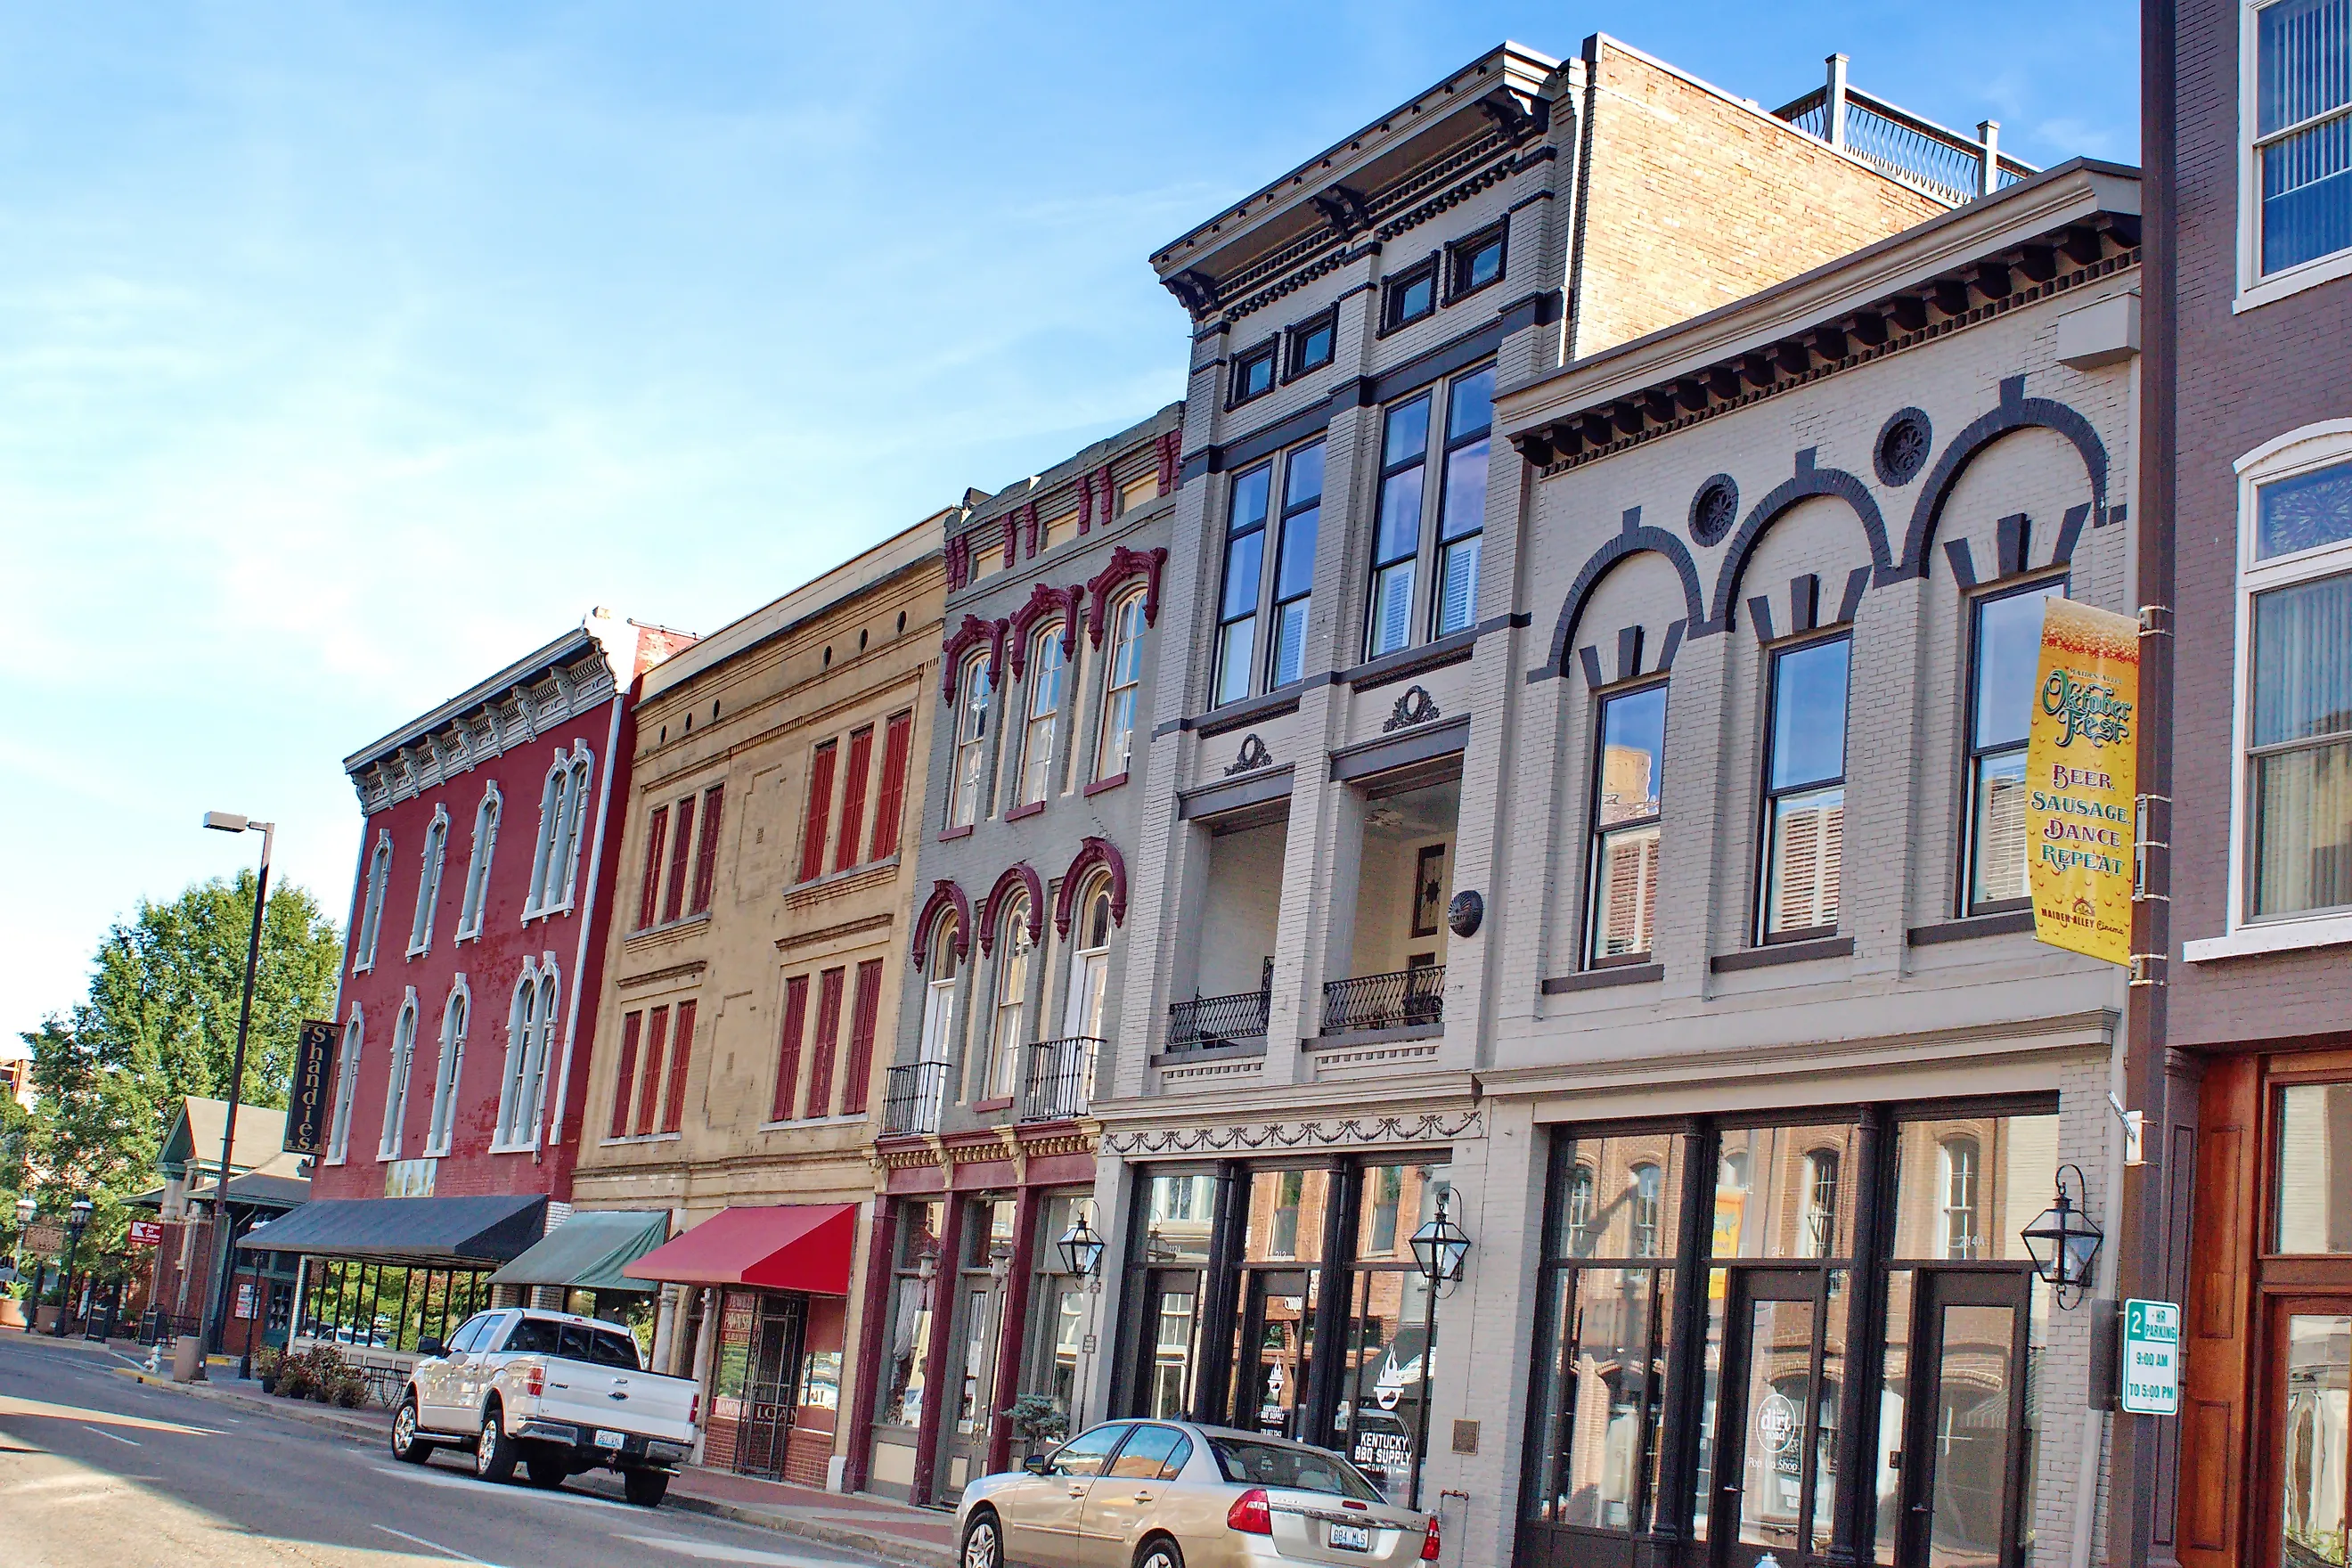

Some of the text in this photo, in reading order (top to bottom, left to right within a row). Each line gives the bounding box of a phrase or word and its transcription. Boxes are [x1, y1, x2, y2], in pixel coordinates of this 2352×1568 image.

[2042, 668, 2133, 723] Oktober
[2054, 708, 2130, 748] Fest
[2052, 764, 2116, 791] BEER.
[2030, 790, 2132, 825] SAUSAGE.
[2043, 819, 2121, 848] DANCE
[2041, 843, 2123, 876] REPEAT
[2041, 907, 2125, 935] MAIDEN ALLEY Cinema
[298, 1025, 326, 1151] Shandies
[1959, 1233, 1985, 1246] 214A
[1771, 1246, 1785, 1256] 214
[2132, 1311, 2142, 1333] 2
[2145, 1324, 2176, 1339] PARKING
[2136, 1352, 2168, 1367] 9:00 AM
[2129, 1383, 2174, 1399] TO 5:00 PM
[1760, 1408, 1792, 1432] dirt
[1360, 1432, 1409, 1451] KENTUCKY
[1766, 1429, 1785, 1441] road
[1355, 1445, 1412, 1466] BBQ SUPPLY
[1748, 1457, 1762, 1470] Pop
[1778, 1458, 1798, 1473] Shop
[1368, 1463, 1397, 1474] COMPANY
